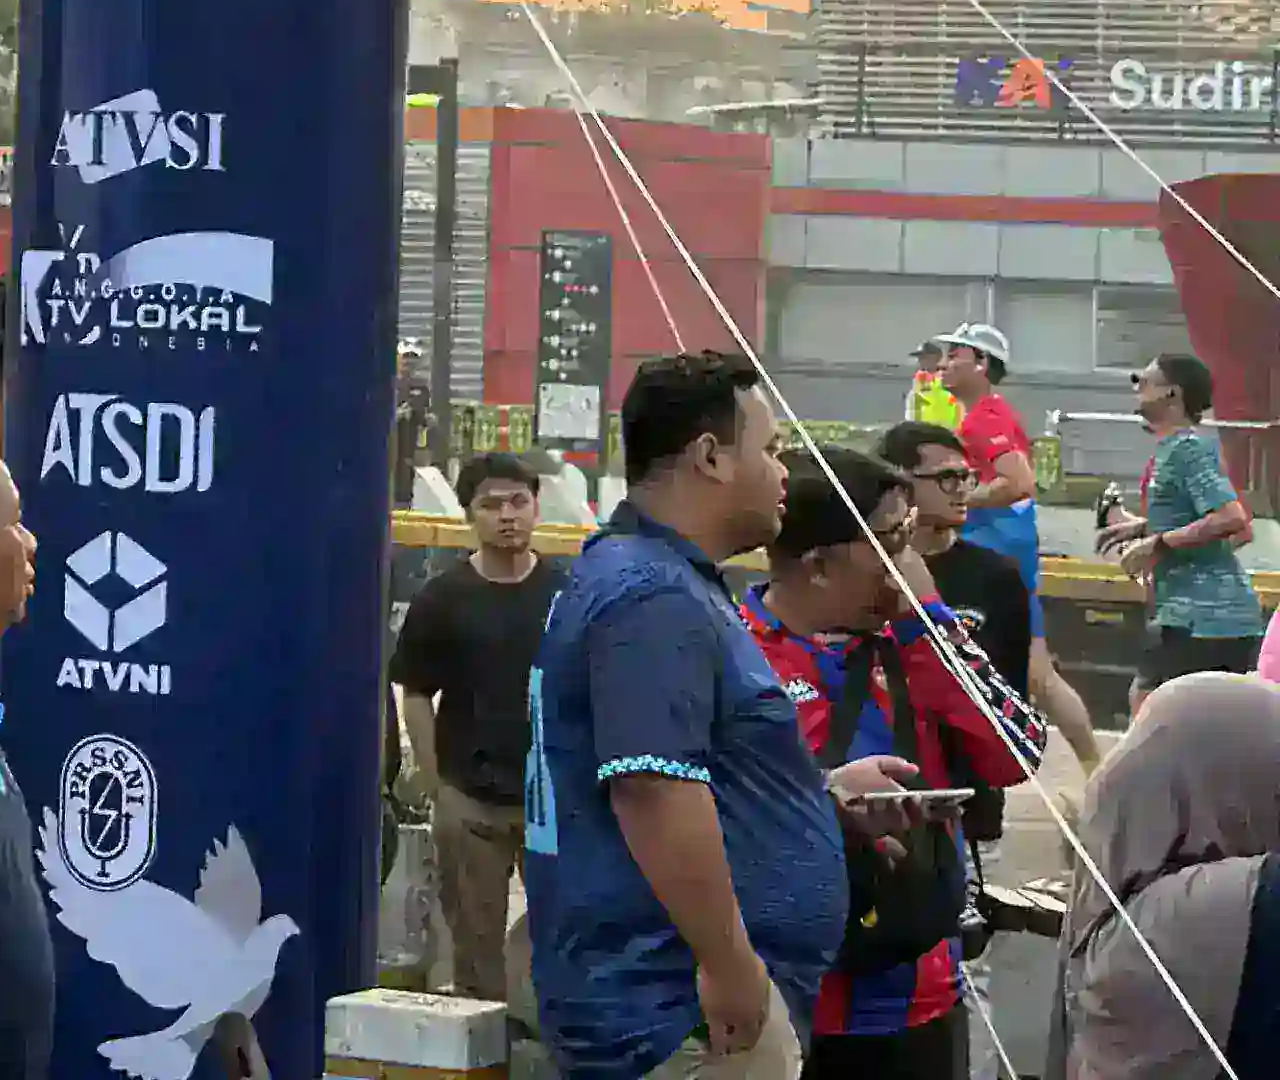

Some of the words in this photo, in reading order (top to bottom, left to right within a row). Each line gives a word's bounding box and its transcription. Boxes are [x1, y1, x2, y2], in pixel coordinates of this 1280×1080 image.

[1108, 57, 1273, 111] Sudir
[49, 109, 228, 171] ATVSI
[46, 299, 91, 327] TV
[109, 299, 263, 333] LOKAL
[41, 393, 215, 492] ATSDI
[56, 657, 172, 696] ATVNI
[69, 746, 144, 807] PRSSNI
